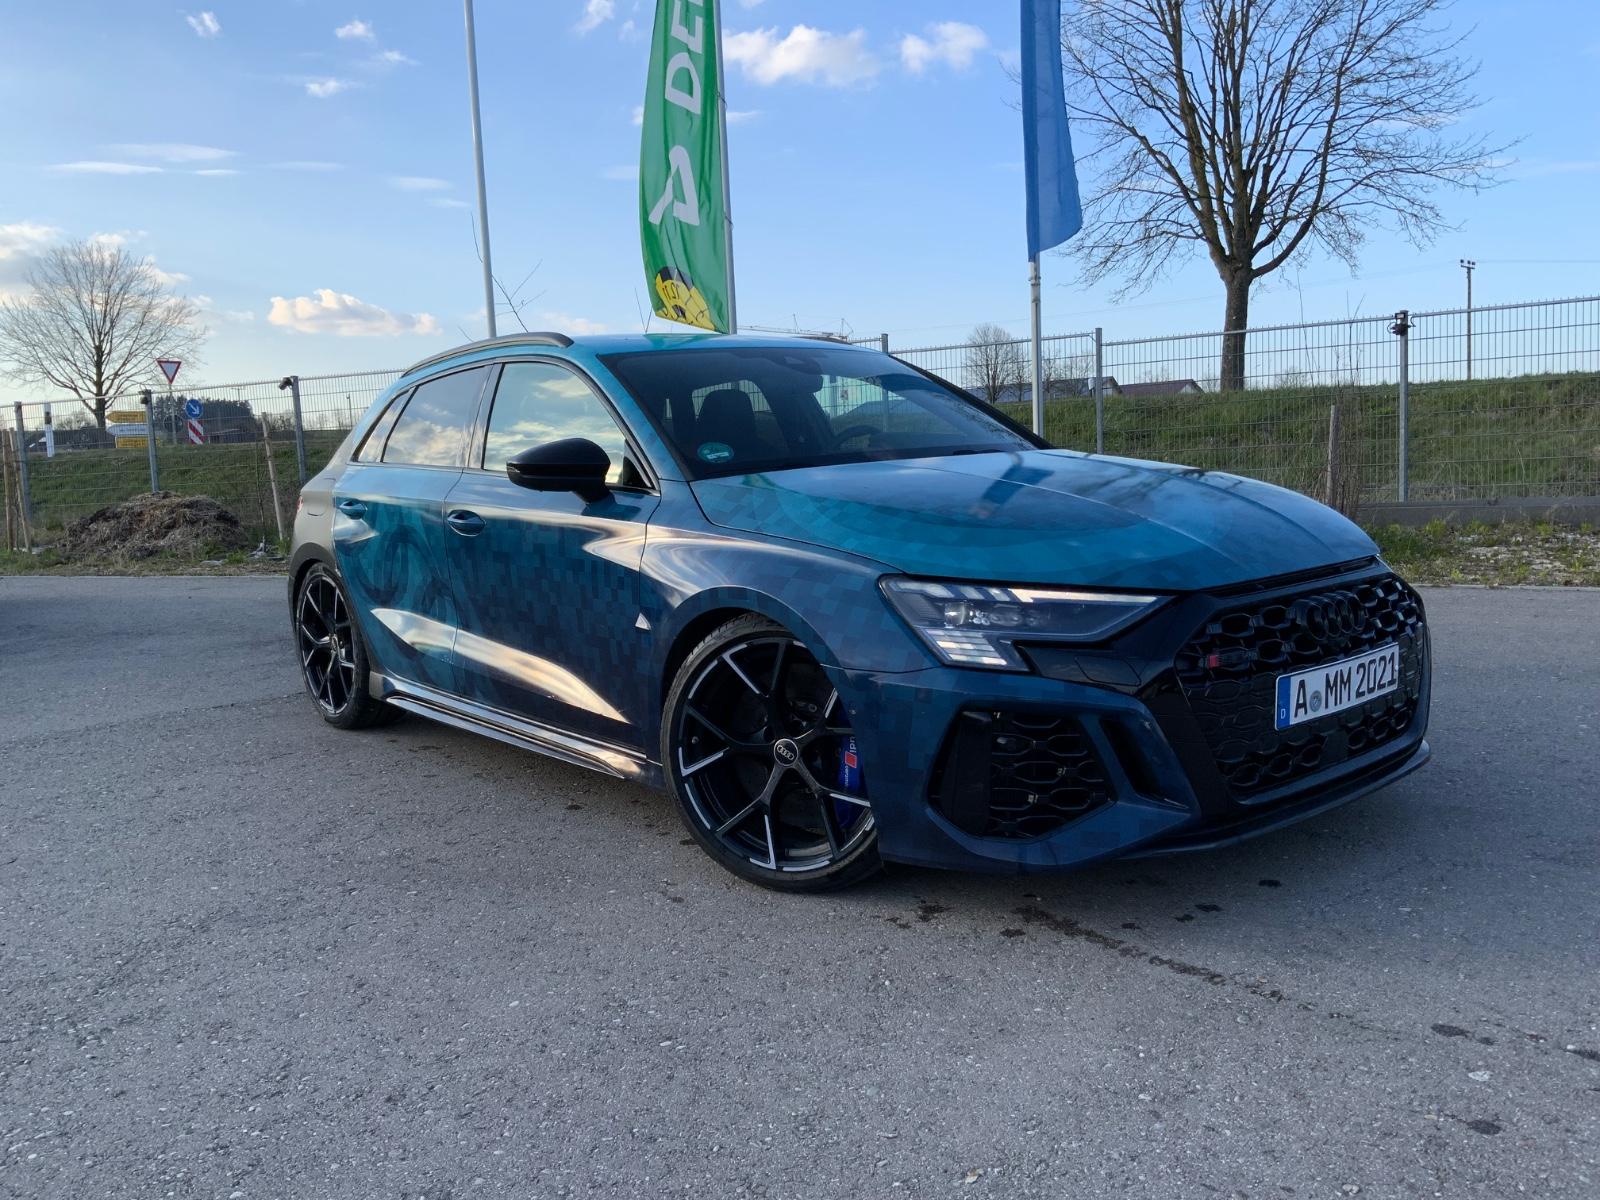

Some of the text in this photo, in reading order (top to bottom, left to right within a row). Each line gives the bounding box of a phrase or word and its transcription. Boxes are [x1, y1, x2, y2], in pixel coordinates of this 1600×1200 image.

[665, 0, 704, 114] DE
[1294, 652, 1397, 718] A MM 2021
